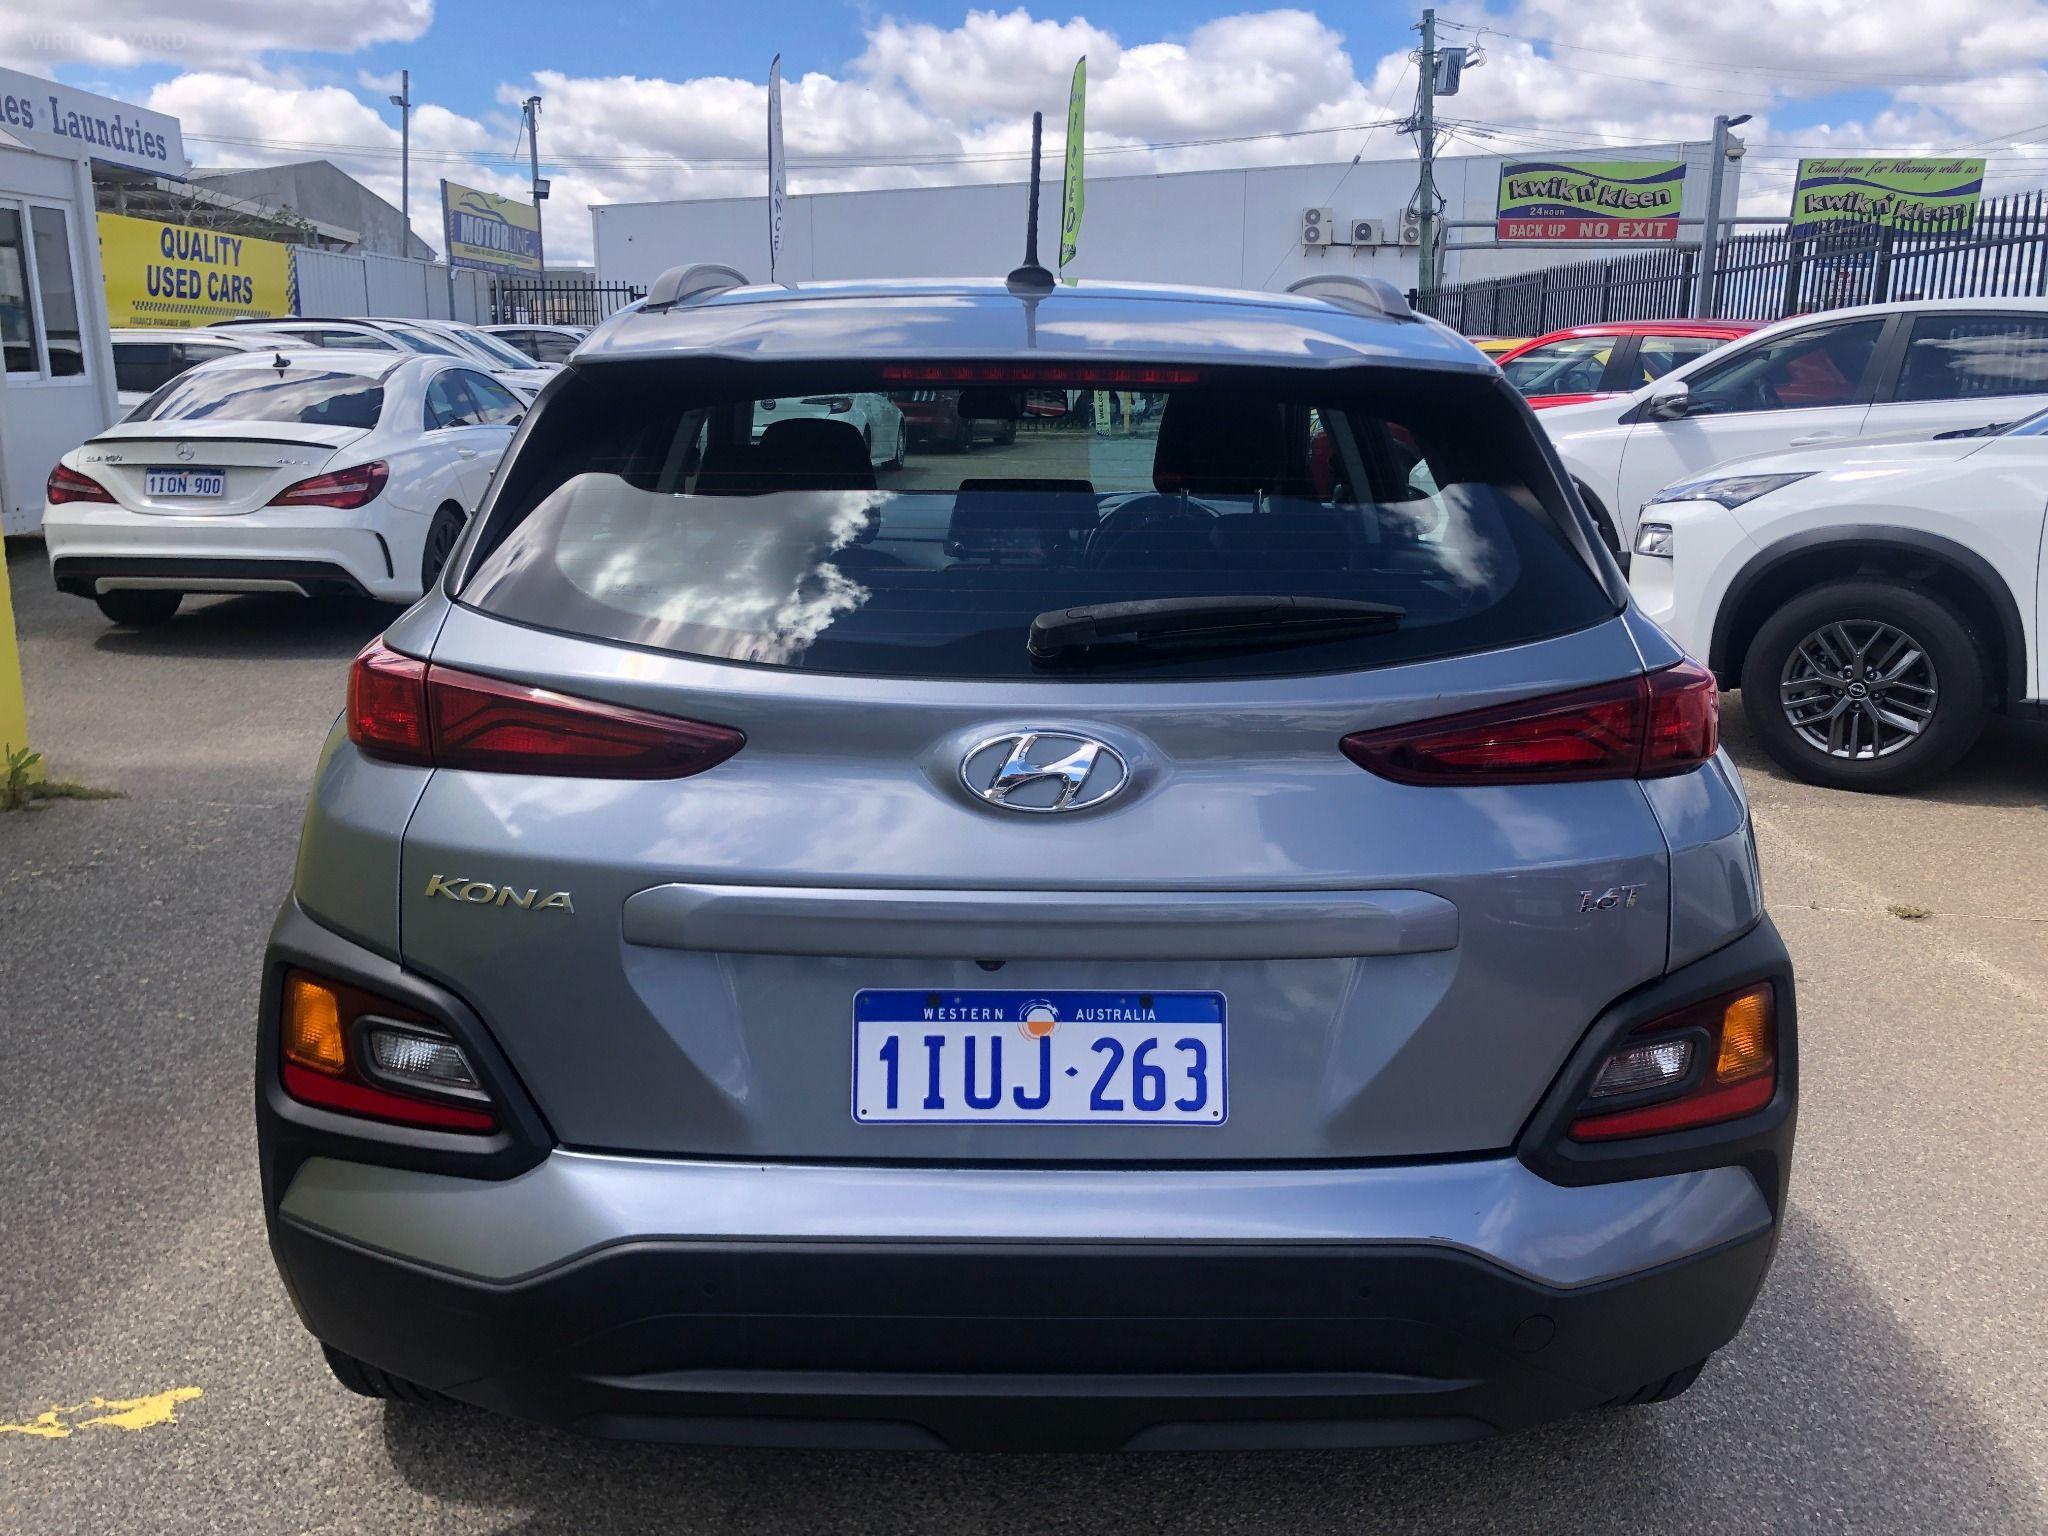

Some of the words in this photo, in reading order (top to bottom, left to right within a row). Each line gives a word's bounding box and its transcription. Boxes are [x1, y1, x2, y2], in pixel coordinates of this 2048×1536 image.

[49, 96, 167, 161] Laundries
[1509, 177, 1578, 201] kwik
[1596, 185, 1672, 210] kleen
[1804, 190, 1873, 216] kwik
[161, 227, 243, 266] QUALITY
[461, 213, 530, 255] MOTORLINE
[1509, 223, 1544, 238] BACK
[1547, 224, 1566, 238] UP
[1578, 222, 1609, 238] NO
[1617, 222, 1668, 238] EXIT
[147, 265, 201, 300] USED
[207, 272, 253, 305] CARS
[424, 874, 575, 915] KONA
[923, 1008, 1004, 1021] WESTERN
[1075, 1008, 1156, 1022] AUSTRALIA
